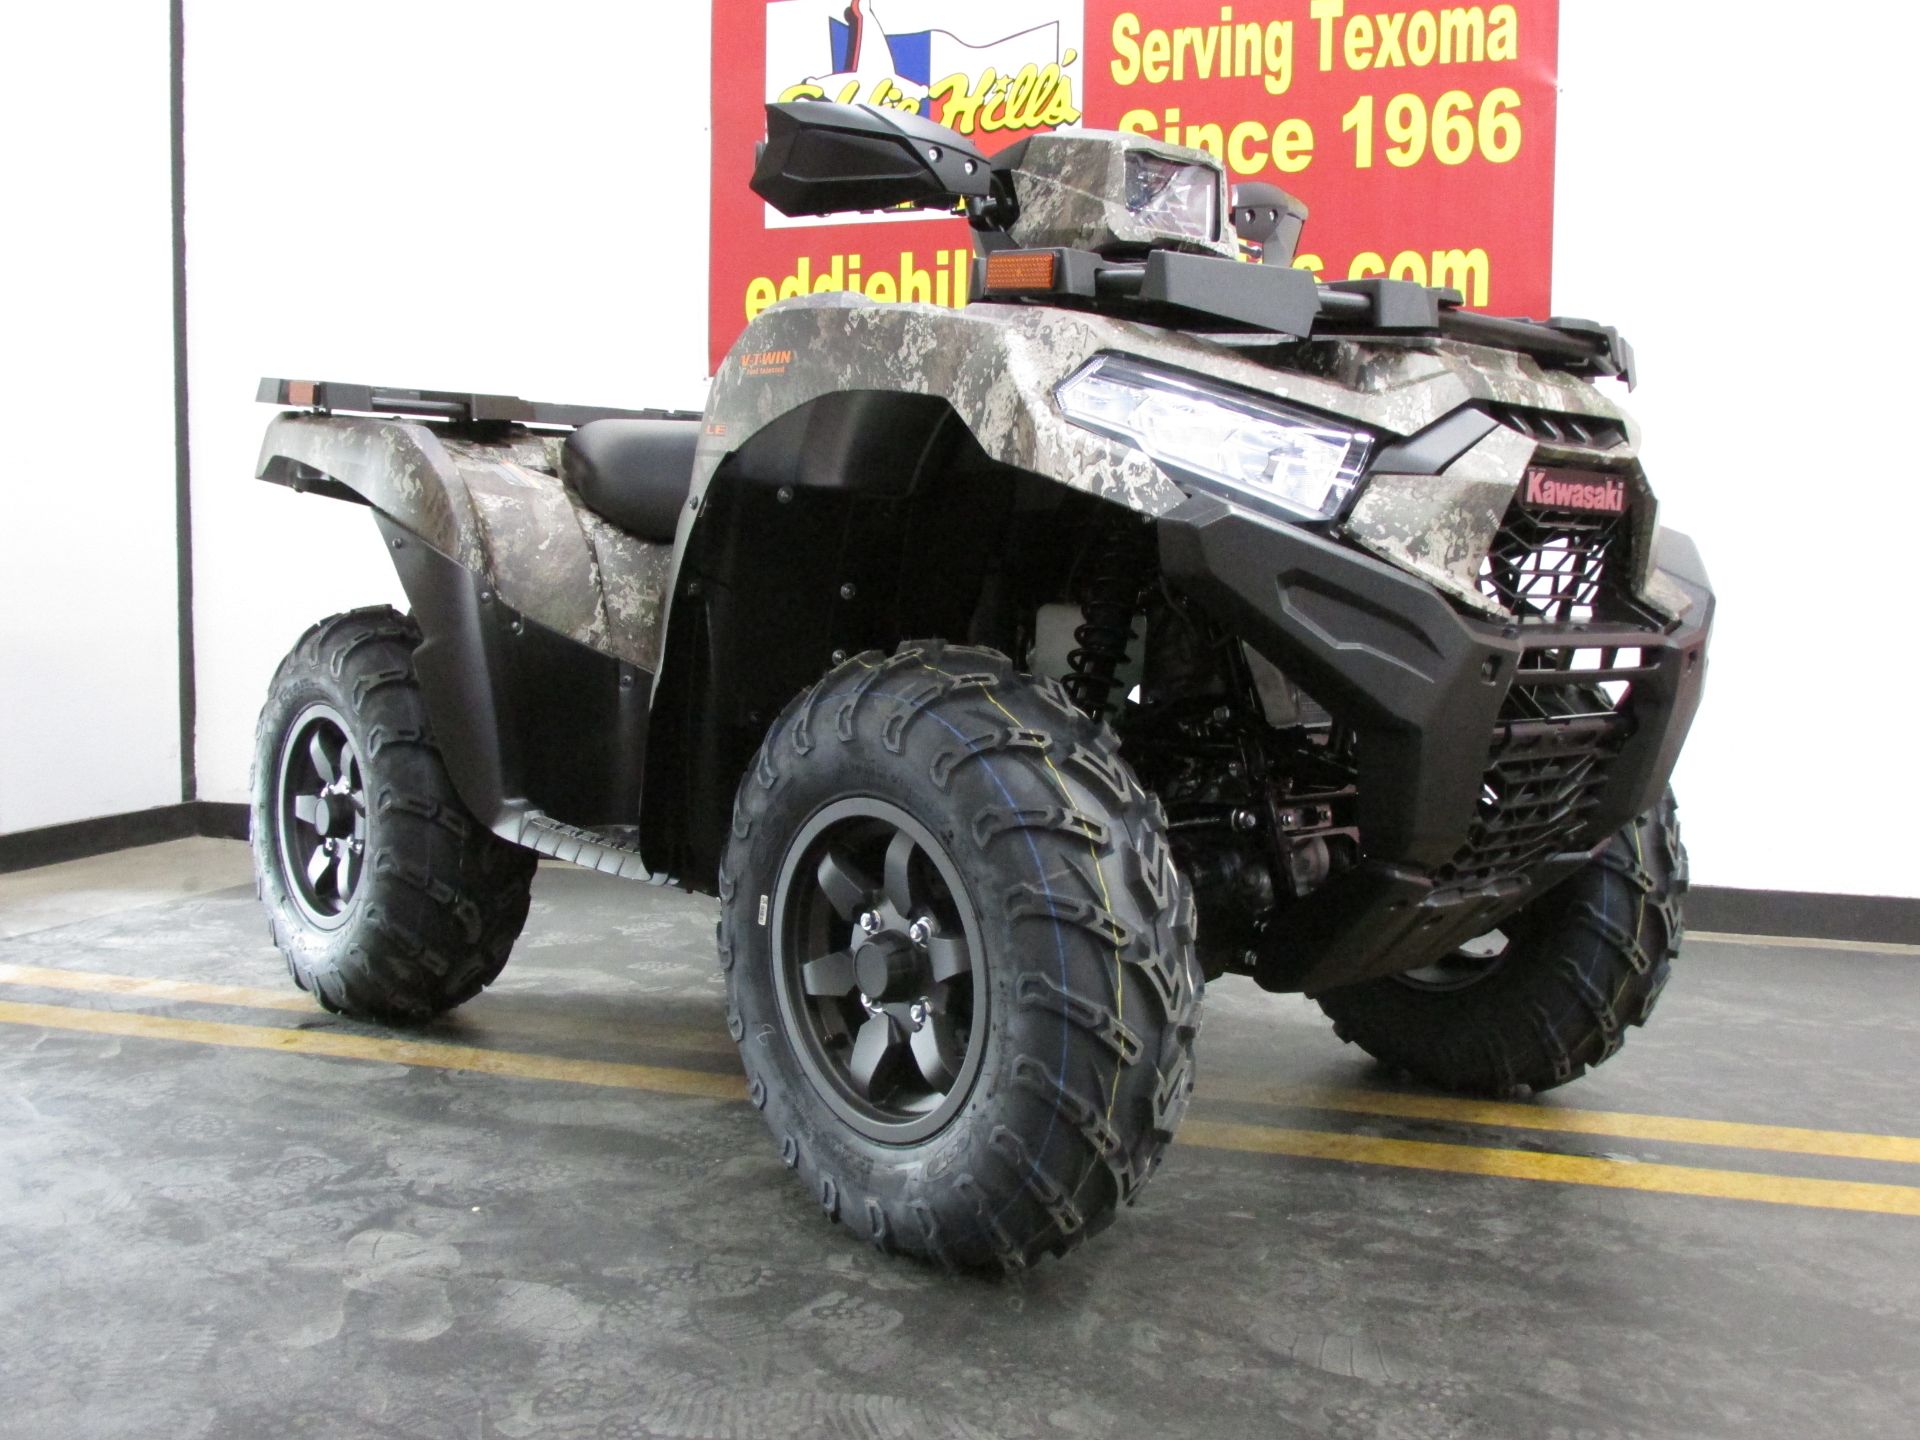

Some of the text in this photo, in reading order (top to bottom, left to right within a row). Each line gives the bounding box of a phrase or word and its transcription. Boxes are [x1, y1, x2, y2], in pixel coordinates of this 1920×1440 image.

[1110, 0, 1518, 95] Serving Texoma
[1342, 87, 1522, 169] 1966
[741, 351, 791, 366] V-TWIN
[1527, 471, 1624, 511] Kawasaki
